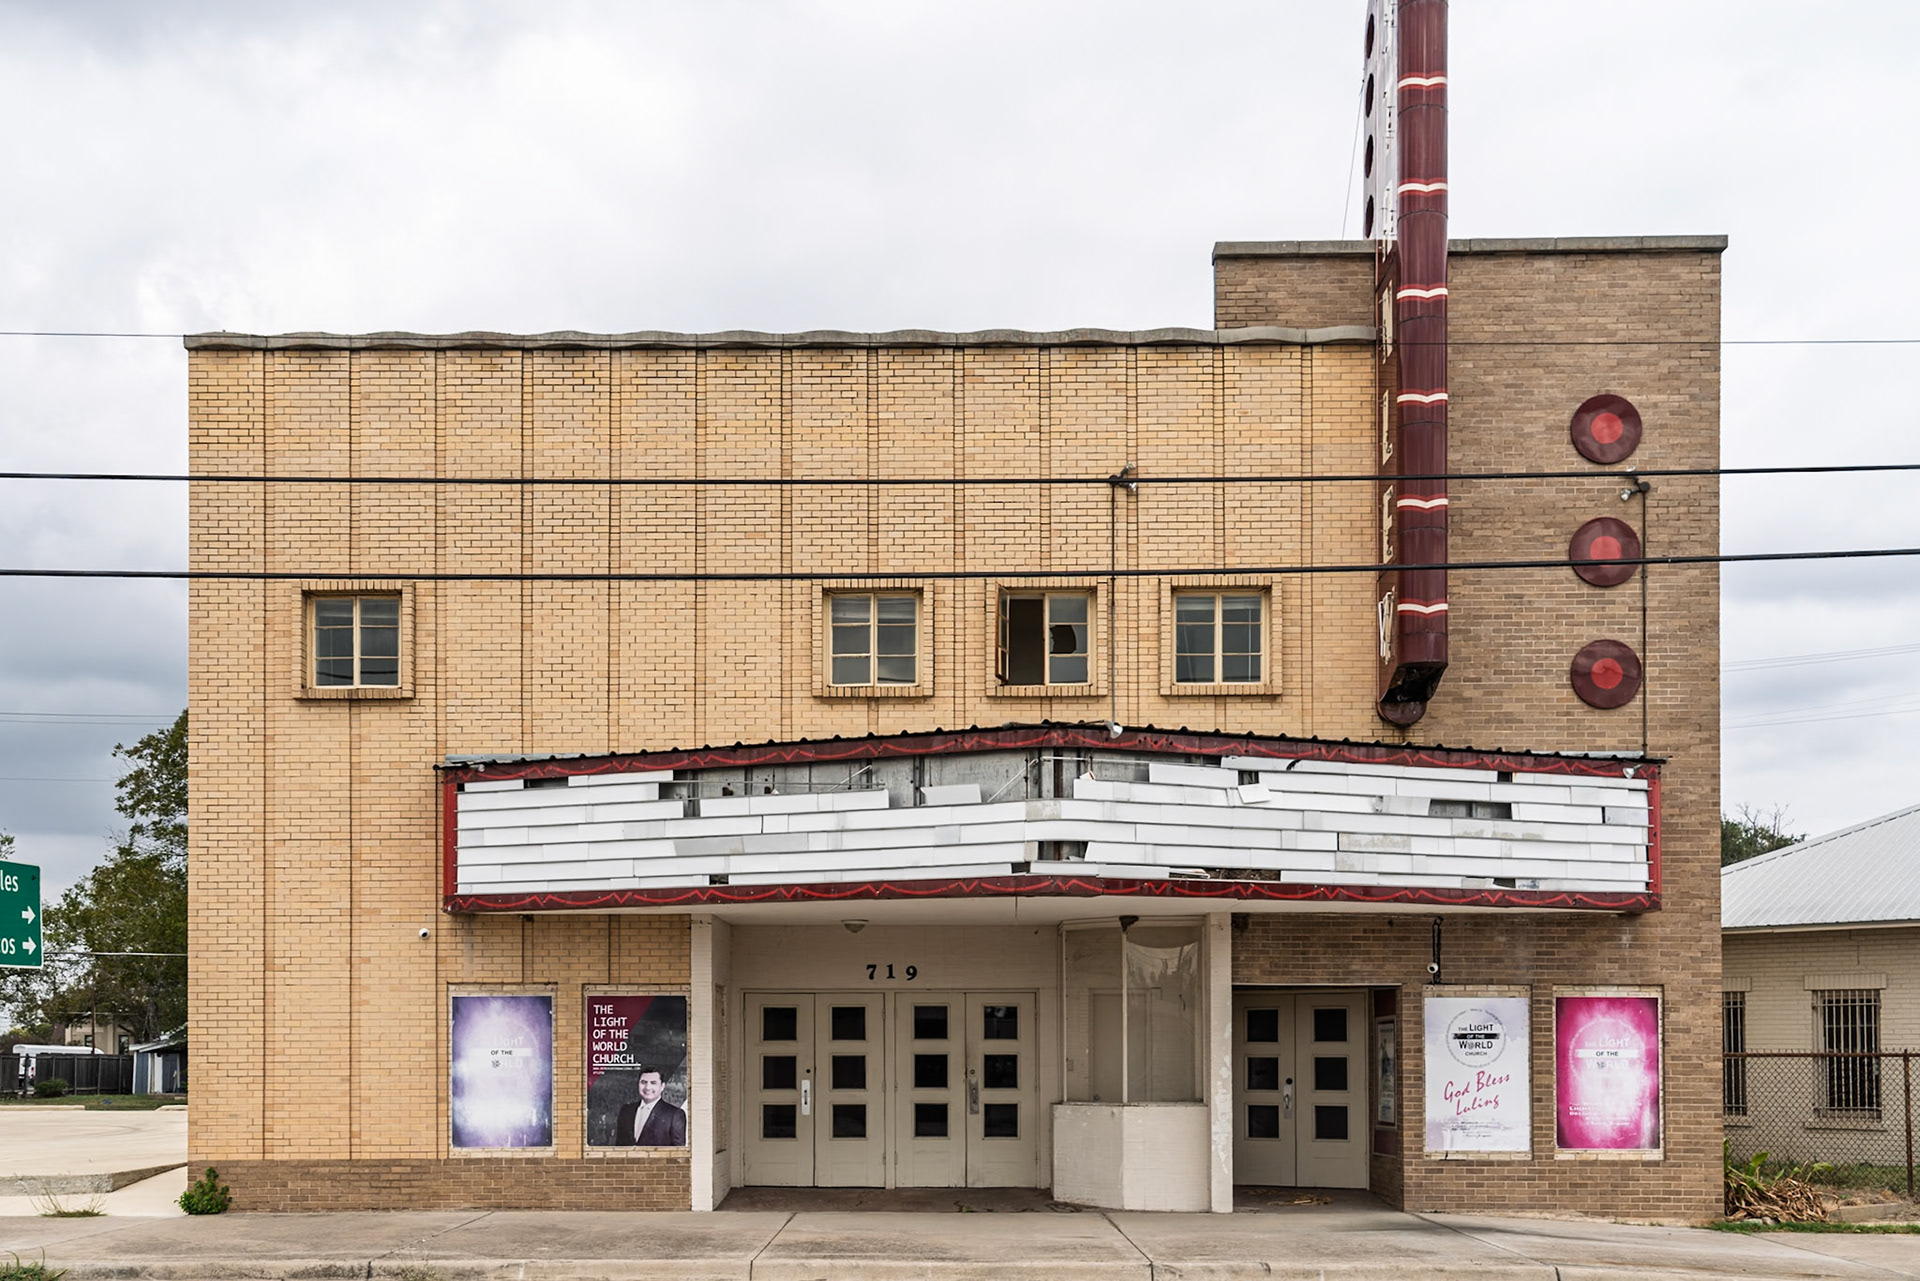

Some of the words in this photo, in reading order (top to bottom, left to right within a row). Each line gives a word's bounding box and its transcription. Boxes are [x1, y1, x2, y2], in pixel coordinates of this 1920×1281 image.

[1, 869, 19, 892] les
[866, 963, 918, 981] 719
[593, 1004, 614, 1014] THE
[593, 1016, 628, 1027] LIGHT
[592, 1028, 607, 1039] OF
[608, 1028, 629, 1039] THE
[592, 1041, 628, 1052] WORLD
[592, 1053, 635, 1064] CHURCH
[1444, 1080, 1470, 1103] God
[1476, 1070, 1510, 1093] Bless
[1456, 1094, 1499, 1116] Luling
